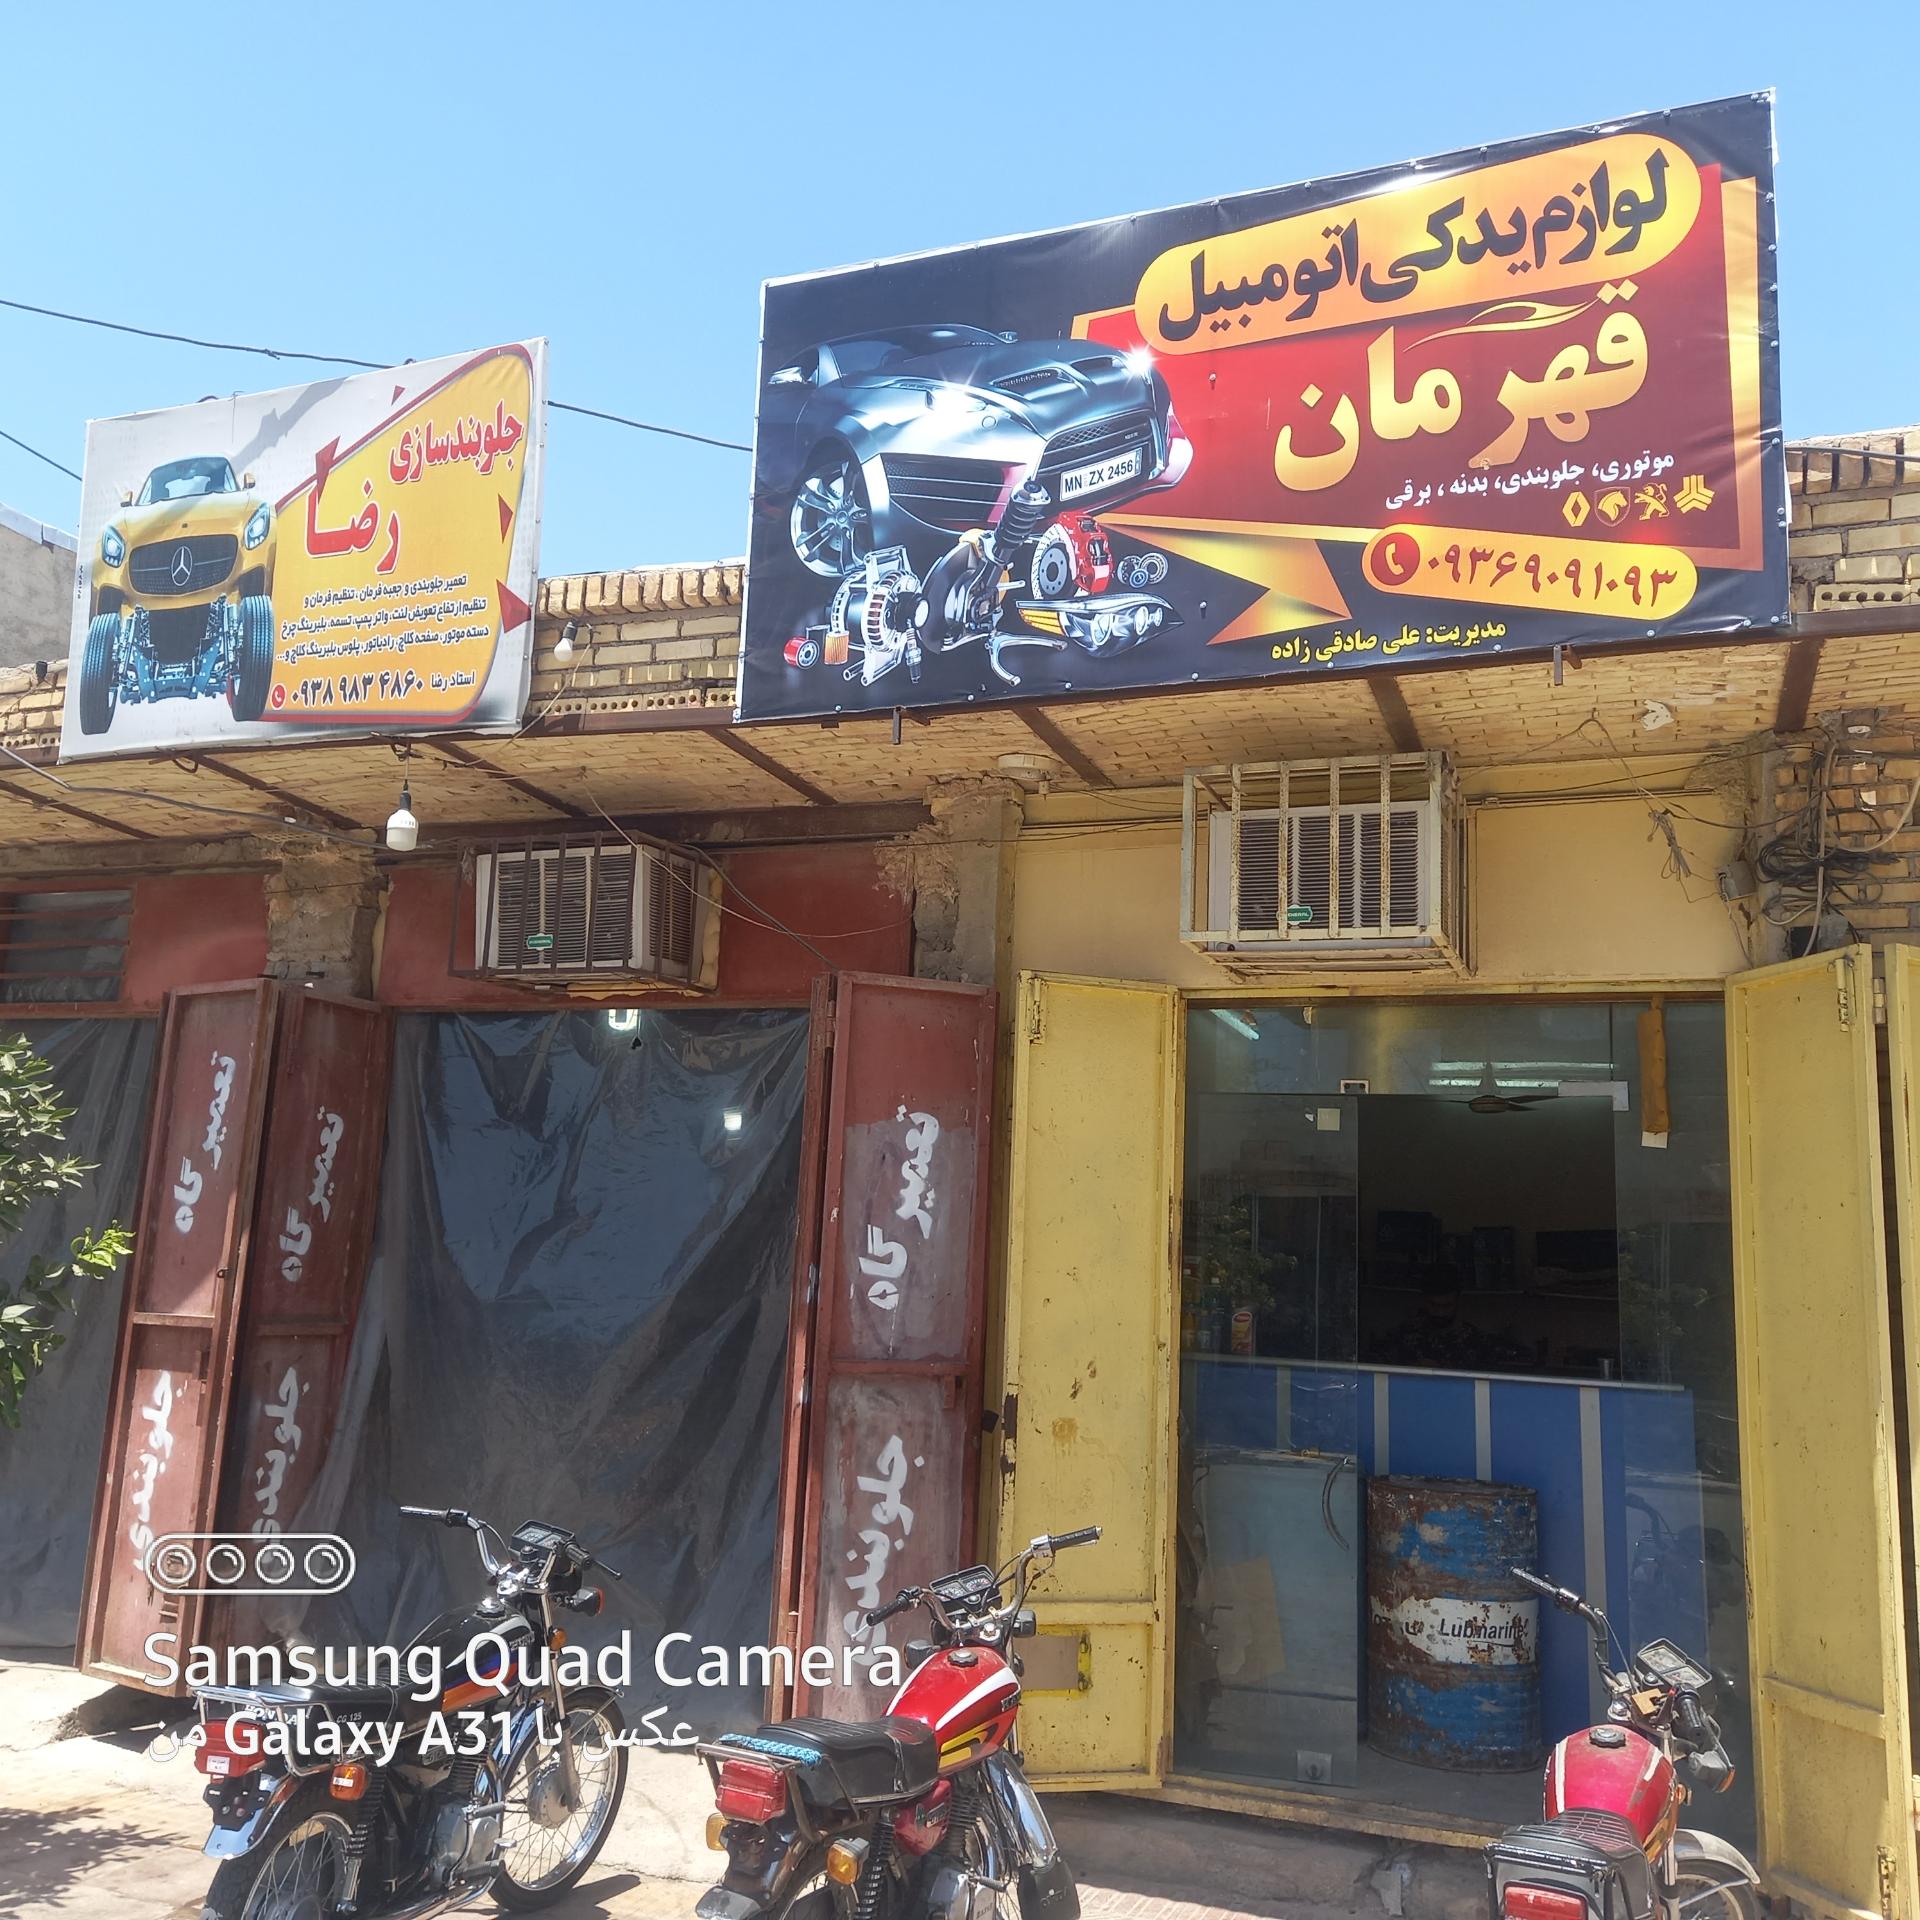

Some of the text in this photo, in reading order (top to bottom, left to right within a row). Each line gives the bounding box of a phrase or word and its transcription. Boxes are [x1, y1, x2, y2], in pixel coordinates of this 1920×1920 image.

[1158, 148, 1670, 342] لوازم یدکی اتومبیل
[1274, 279, 1649, 492] قهرمان
[1064, 460, 1133, 494] MN ZX 2456
[1385, 479, 1431, 509] برقی
[306, 480, 399, 573] رضا
[444, 575, 467, 591] تعمیر
[1426, 543, 1678, 608] ۰۹۳۶۹۰۹۱۰۹۳
[404, 584, 409, 596] و
[410, 577, 443, 595] جلوبندی
[310, 590, 331, 608] فرمان
[332, 589, 354, 605] تنظیم
[408, 605, 437, 621] تعویض
[436, 601, 461, 622] ارتفاع
[462, 598, 486, 615] تنظیم
[281, 622, 296, 639] چرخ
[297, 617, 327, 632] بلبرینگ
[466, 626, 489, 638] دسته
[415, 630, 438, 643] صفحه
[1271, 620, 1507, 664] مدیریت: علی صادقی زاده
[290, 644, 306, 664] کلاچ
[306, 642, 336, 658] بلبرینگ
[337, 639, 360, 656] پلوس
[430, 674, 448, 691] رضا
[449, 671, 475, 689] استاد
[350, 1711, 362, 1721] 125
